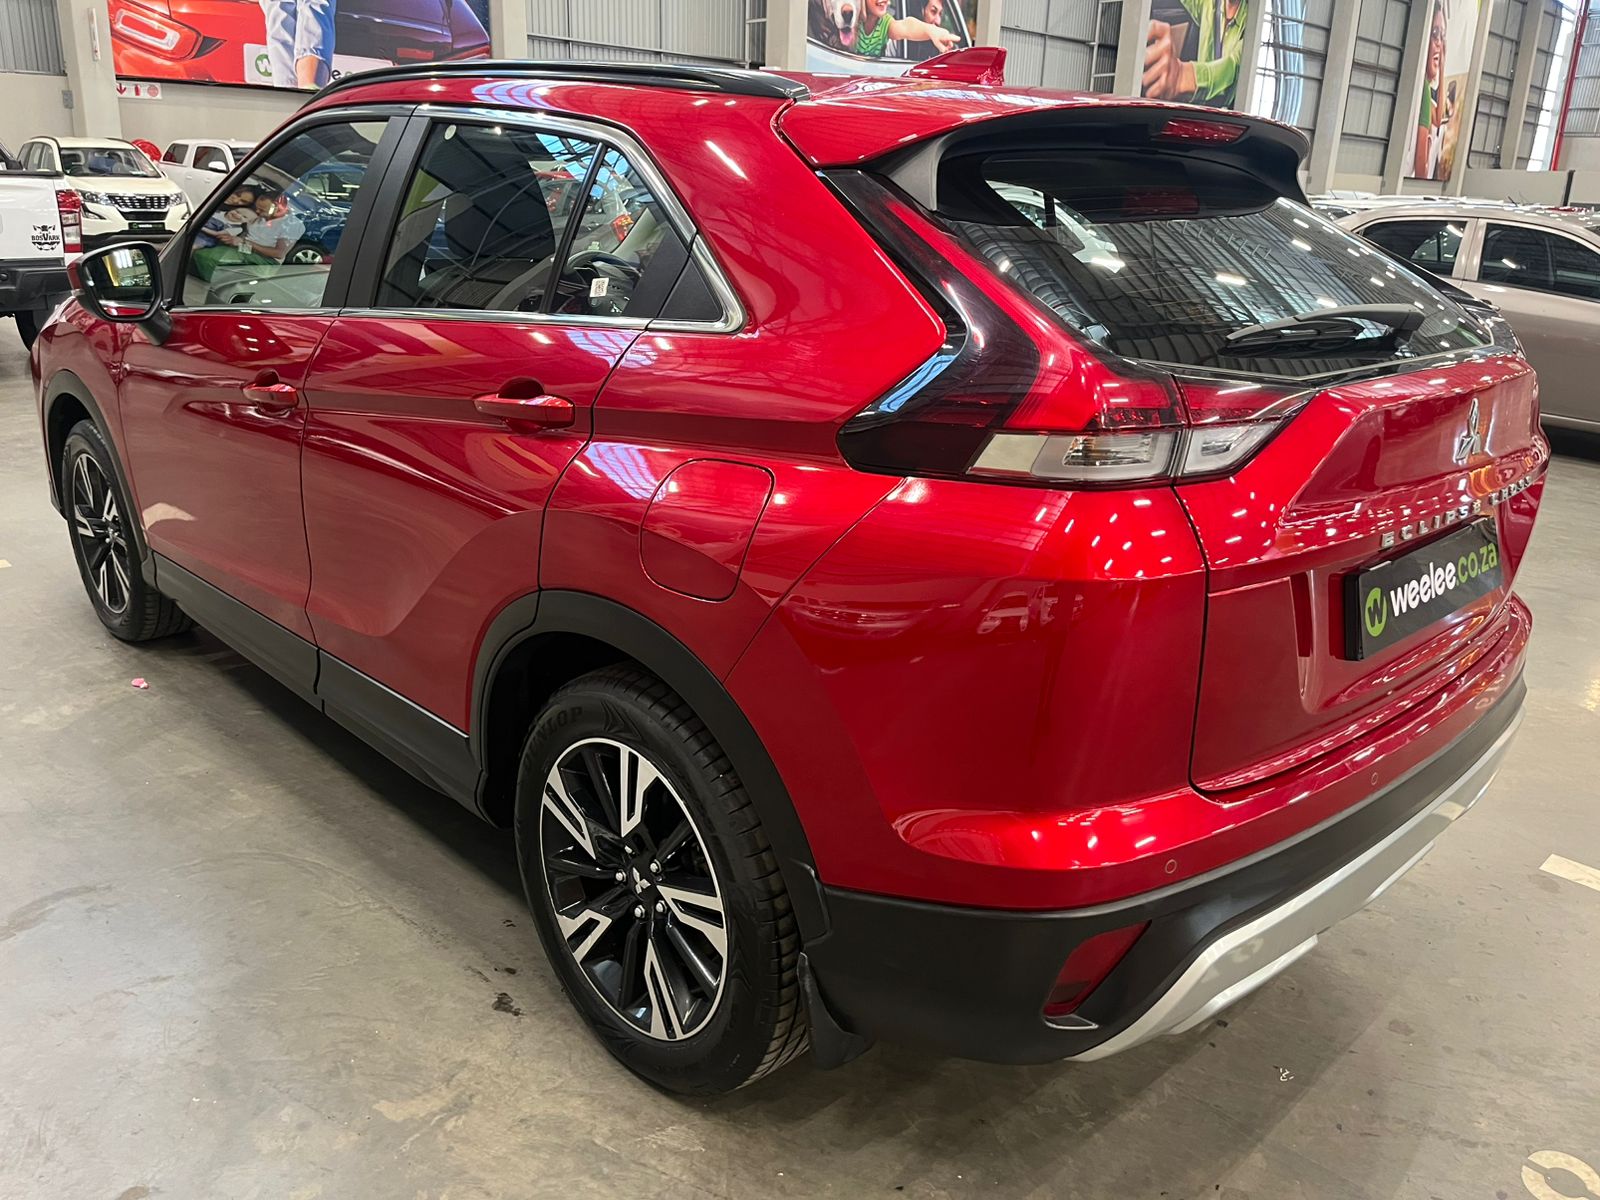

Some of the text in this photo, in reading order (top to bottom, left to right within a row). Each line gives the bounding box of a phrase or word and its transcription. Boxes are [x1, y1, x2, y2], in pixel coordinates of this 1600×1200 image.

[31, 232, 60, 241] BOSVARK
[1381, 500, 1482, 548] ECLIPSE
[1390, 543, 1498, 617] weelee.co.za
